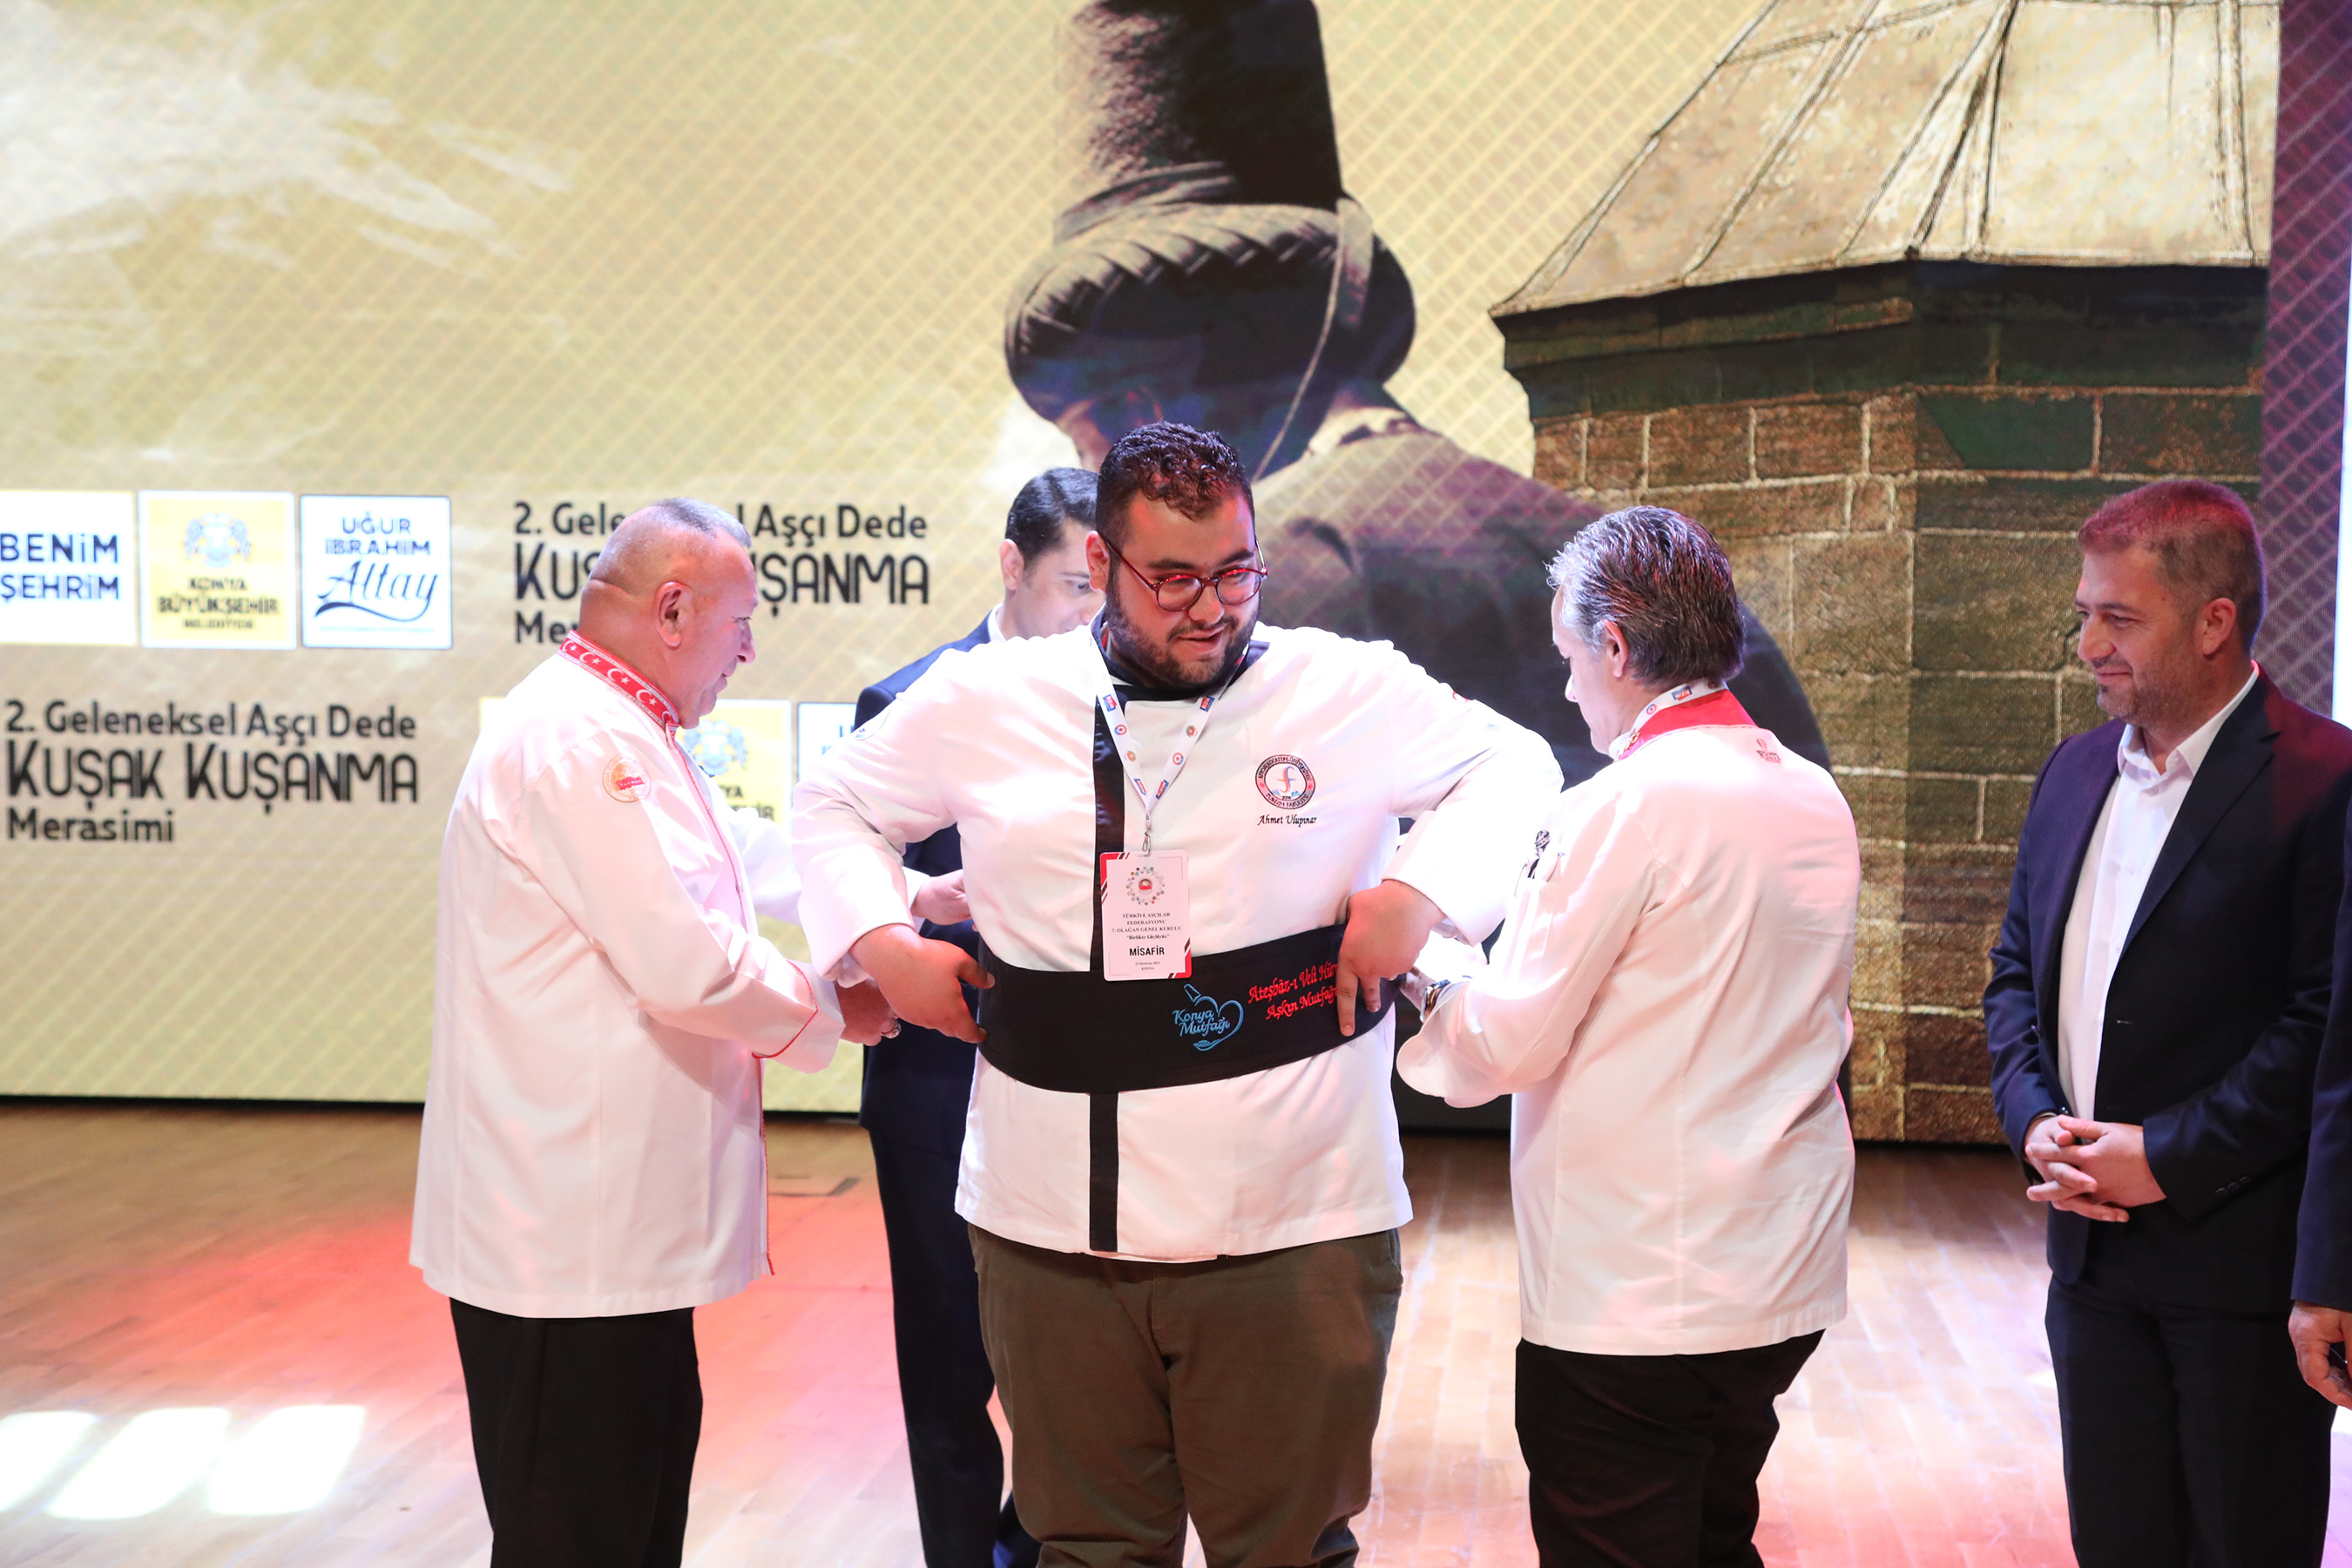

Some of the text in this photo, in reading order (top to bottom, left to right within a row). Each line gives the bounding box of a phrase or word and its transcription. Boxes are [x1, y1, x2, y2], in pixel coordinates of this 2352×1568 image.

[342, 511, 411, 534] UĞUR
[514, 501, 541, 535] 2.
[754, 504, 825, 547] Aşçı
[837, 504, 927, 538] Dede
[315, 559, 438, 622] Altay
[7, 700, 416, 747] 2. Geleneksel Aşçı Dede
[8, 740, 417, 815] KUŞAK KUŞANMA
[8, 807, 173, 841] Merasimi
[1257, 814, 1283, 826] Ahmet
[1129, 945, 1165, 956] MİSAFİR
[1299, 965, 1318, 988] Veli
[1172, 1009, 1214, 1024] Konya
[1266, 999, 1299, 1020] Aşkın
[1179, 1017, 1231, 1037] Mutfağı
